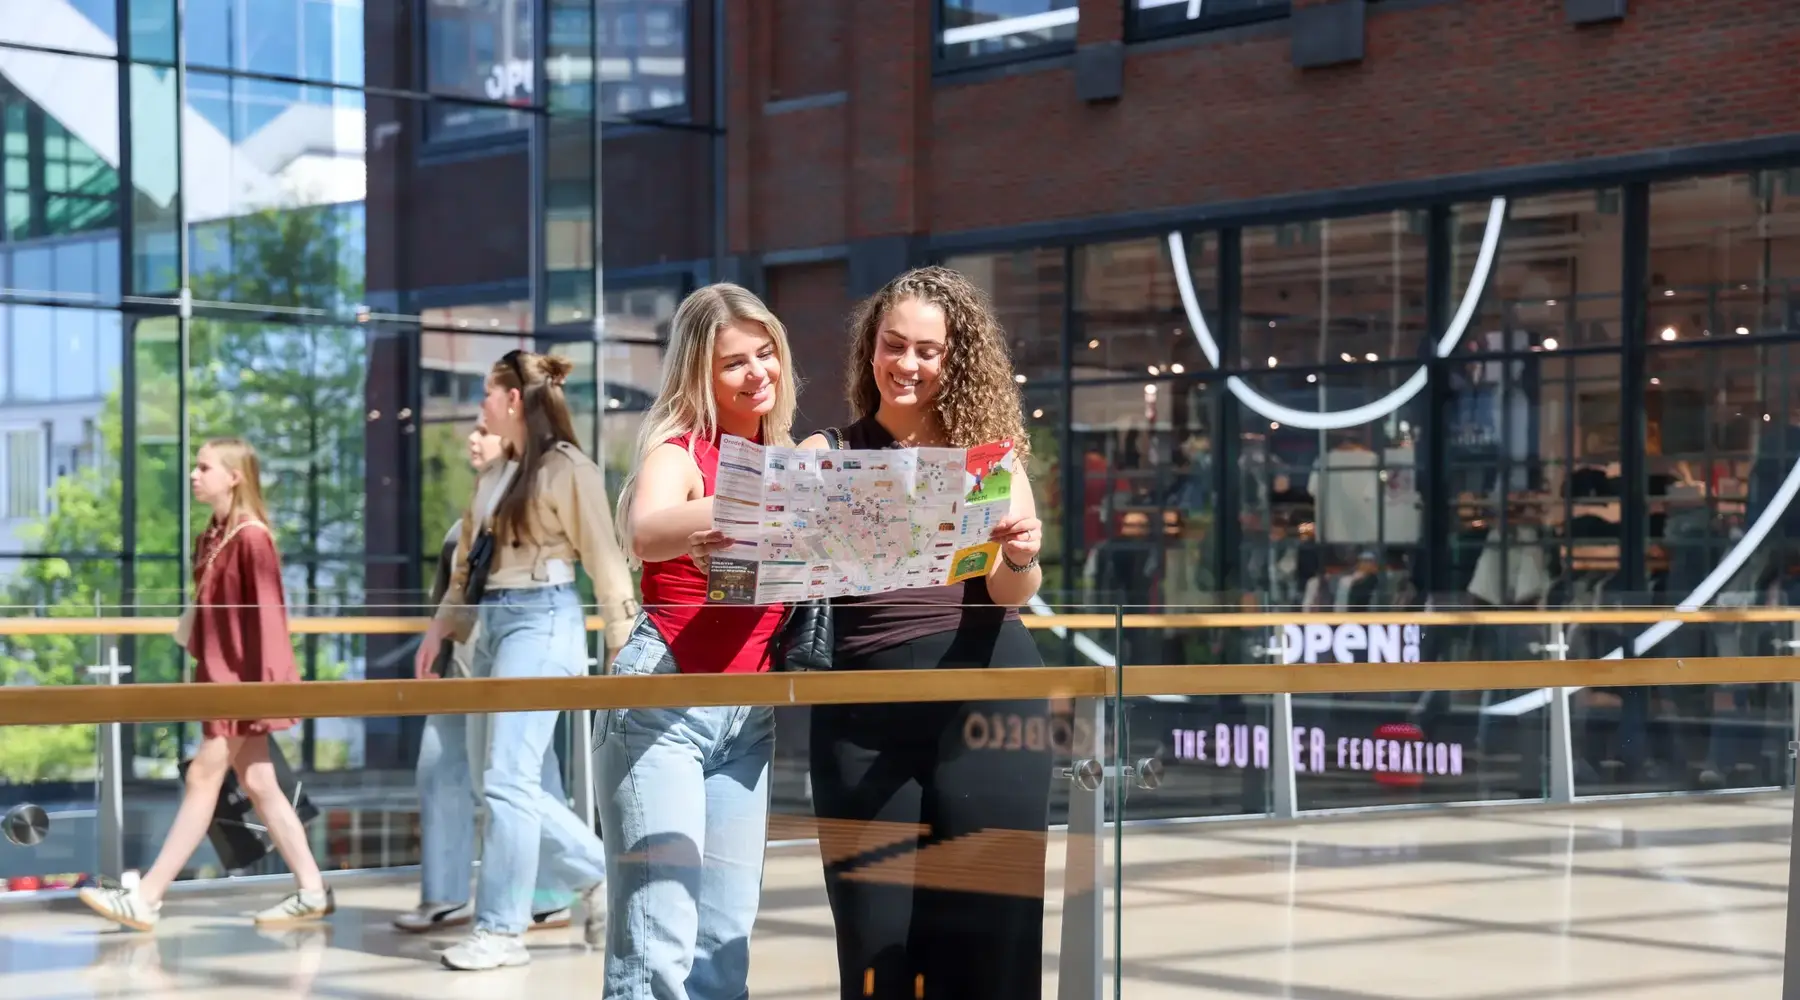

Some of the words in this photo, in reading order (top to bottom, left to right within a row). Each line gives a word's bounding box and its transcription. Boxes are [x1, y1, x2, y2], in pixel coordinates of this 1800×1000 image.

[1172, 729, 1207, 760] THE
[1215, 723, 1325, 773] BURER
[1337, 736, 1462, 775] FEDERATION
